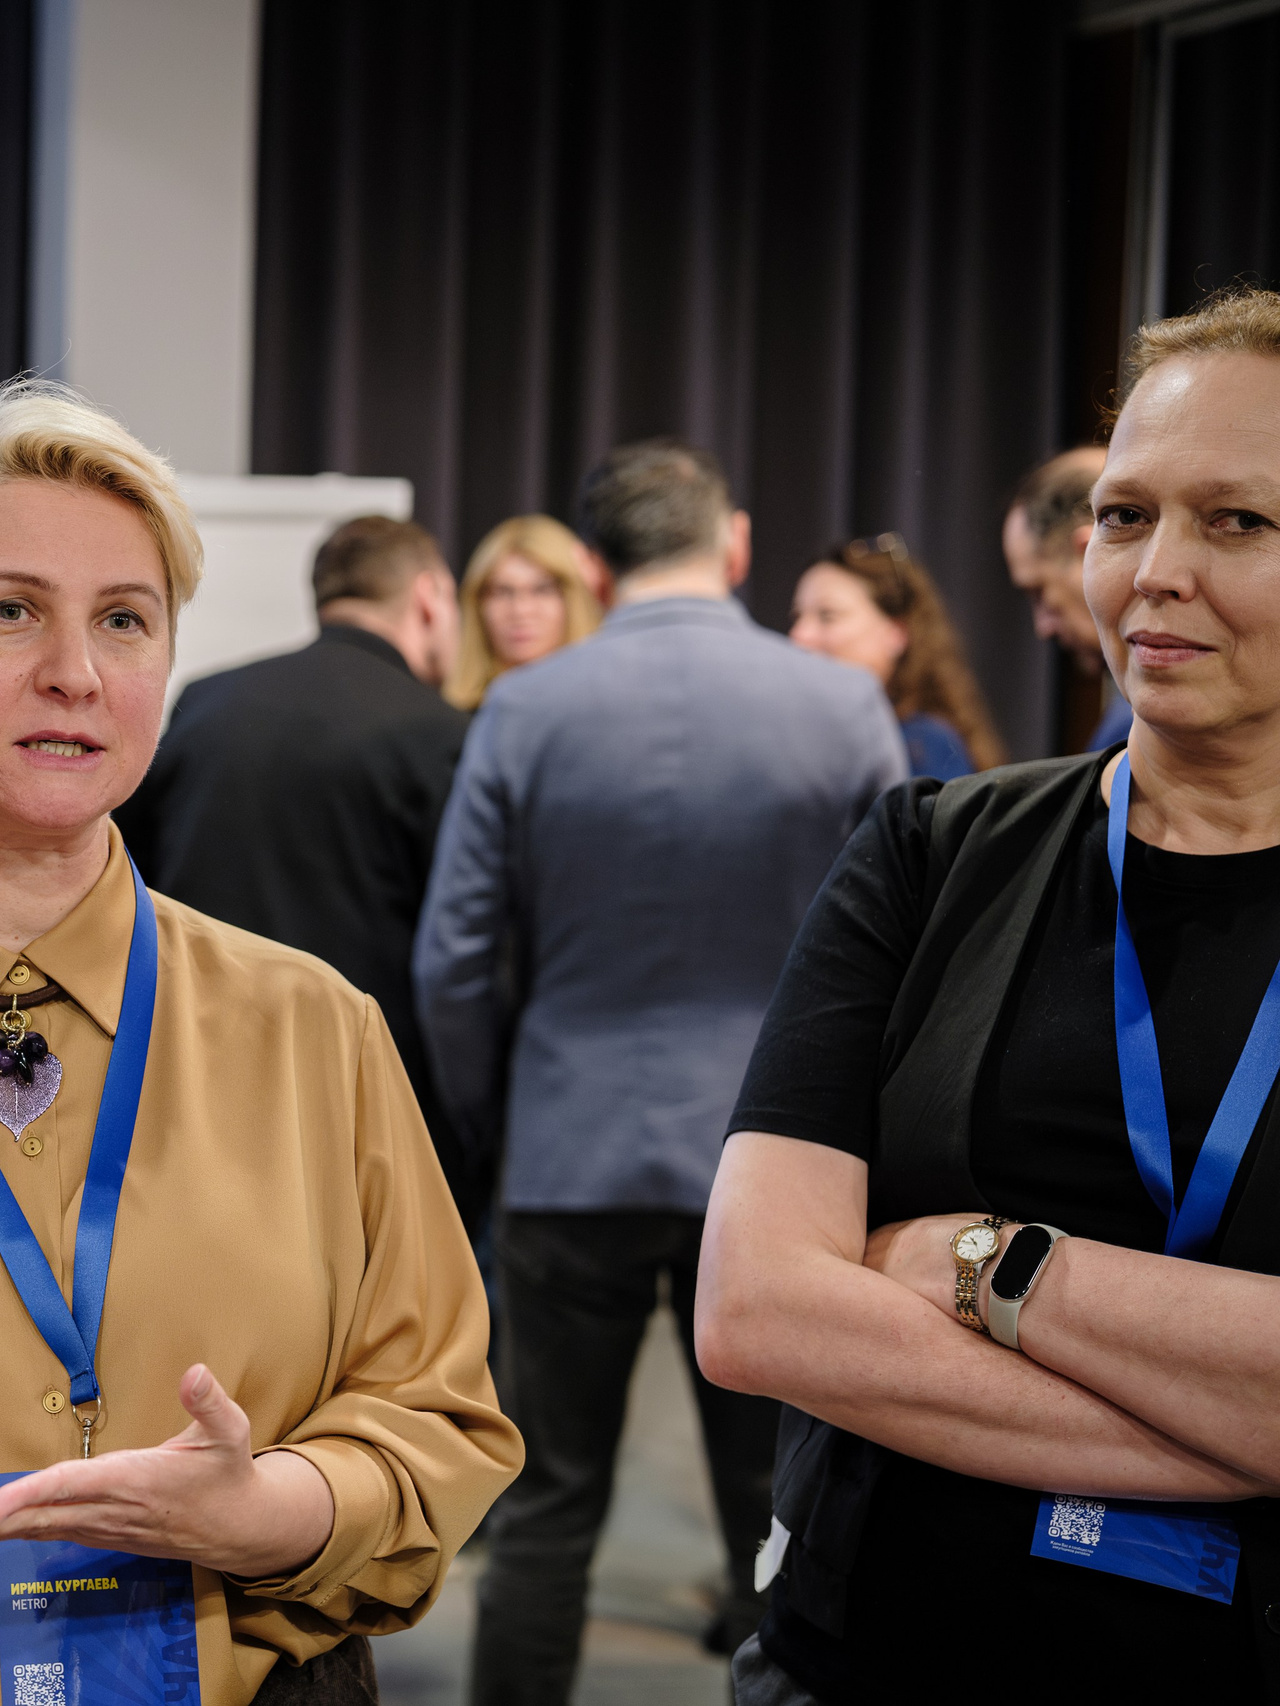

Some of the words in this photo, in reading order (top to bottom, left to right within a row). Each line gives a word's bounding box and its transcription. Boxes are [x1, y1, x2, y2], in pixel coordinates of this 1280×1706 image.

[10, 1580, 54, 1596] ИРИНА
[55, 1577, 119, 1593] КУРГАЕВА
[12, 1597, 48, 1611] METRO
